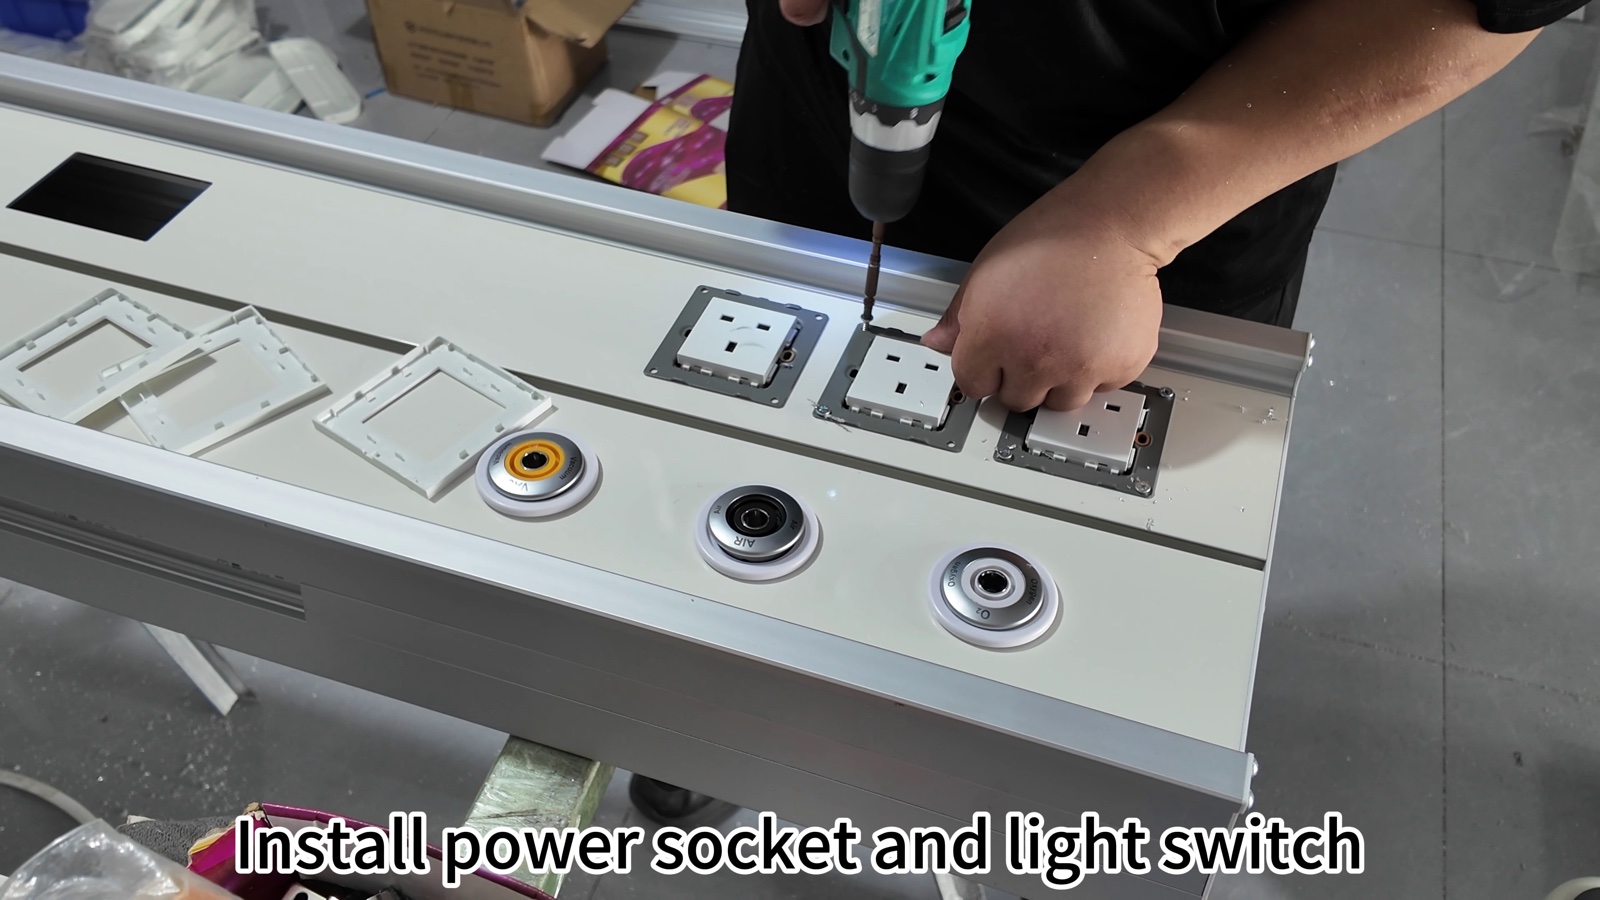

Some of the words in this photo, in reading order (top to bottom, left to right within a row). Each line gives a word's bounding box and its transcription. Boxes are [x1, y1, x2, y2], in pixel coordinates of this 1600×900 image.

[559, 456, 577, 480] Vacuum
[733, 536, 756, 548] AIR
[947, 561, 961, 588] Oxygen
[1026, 578, 1038, 606] Oxygen
